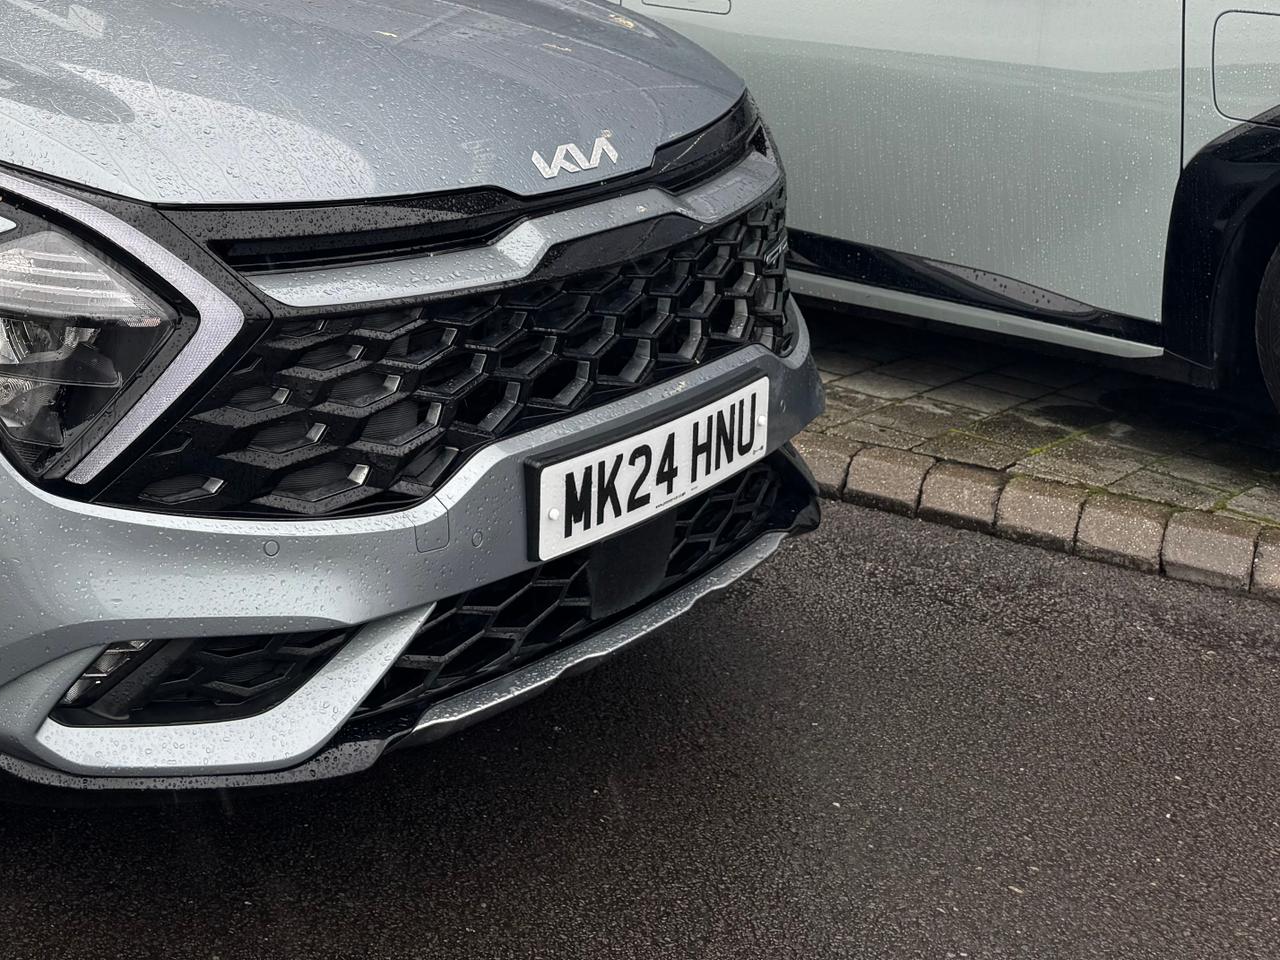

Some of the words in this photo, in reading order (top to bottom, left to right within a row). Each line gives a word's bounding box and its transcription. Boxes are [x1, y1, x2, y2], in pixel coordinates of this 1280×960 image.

[531, 137, 619, 179] KIA
[563, 431, 679, 539] MK24
[690, 392, 757, 484] HNU
